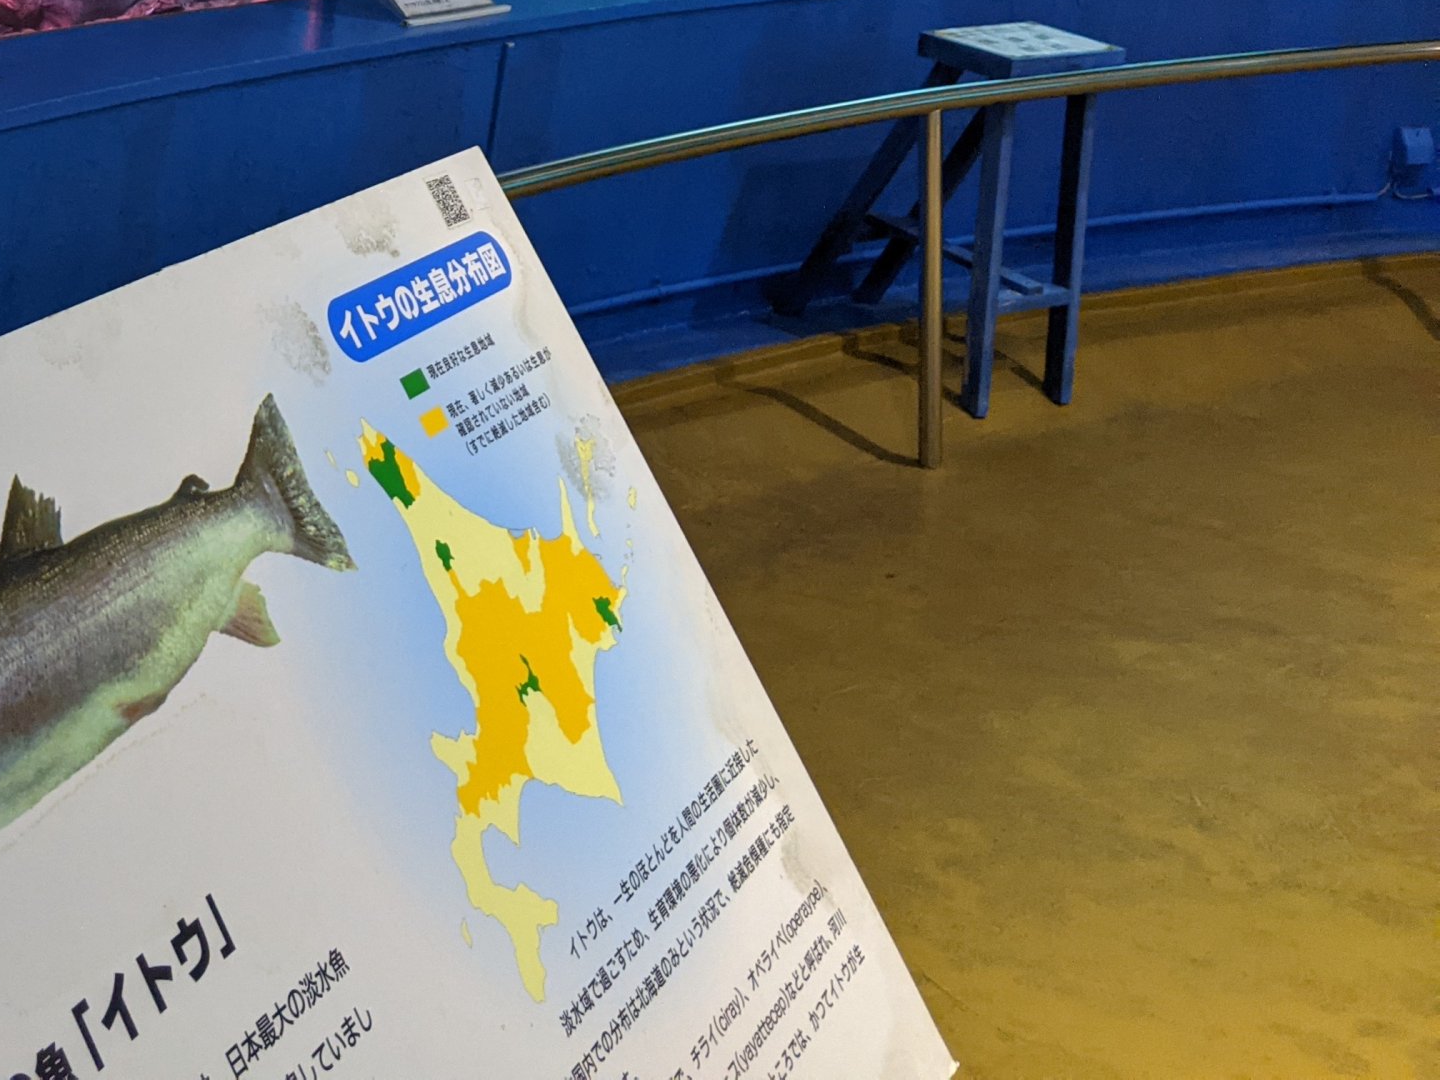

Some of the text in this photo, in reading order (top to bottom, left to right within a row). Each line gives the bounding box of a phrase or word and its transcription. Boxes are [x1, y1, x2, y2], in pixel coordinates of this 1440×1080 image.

[340, 242, 506, 350] イトウの生息分布図
[426, 332, 496, 380] 現在良好な生息地域
